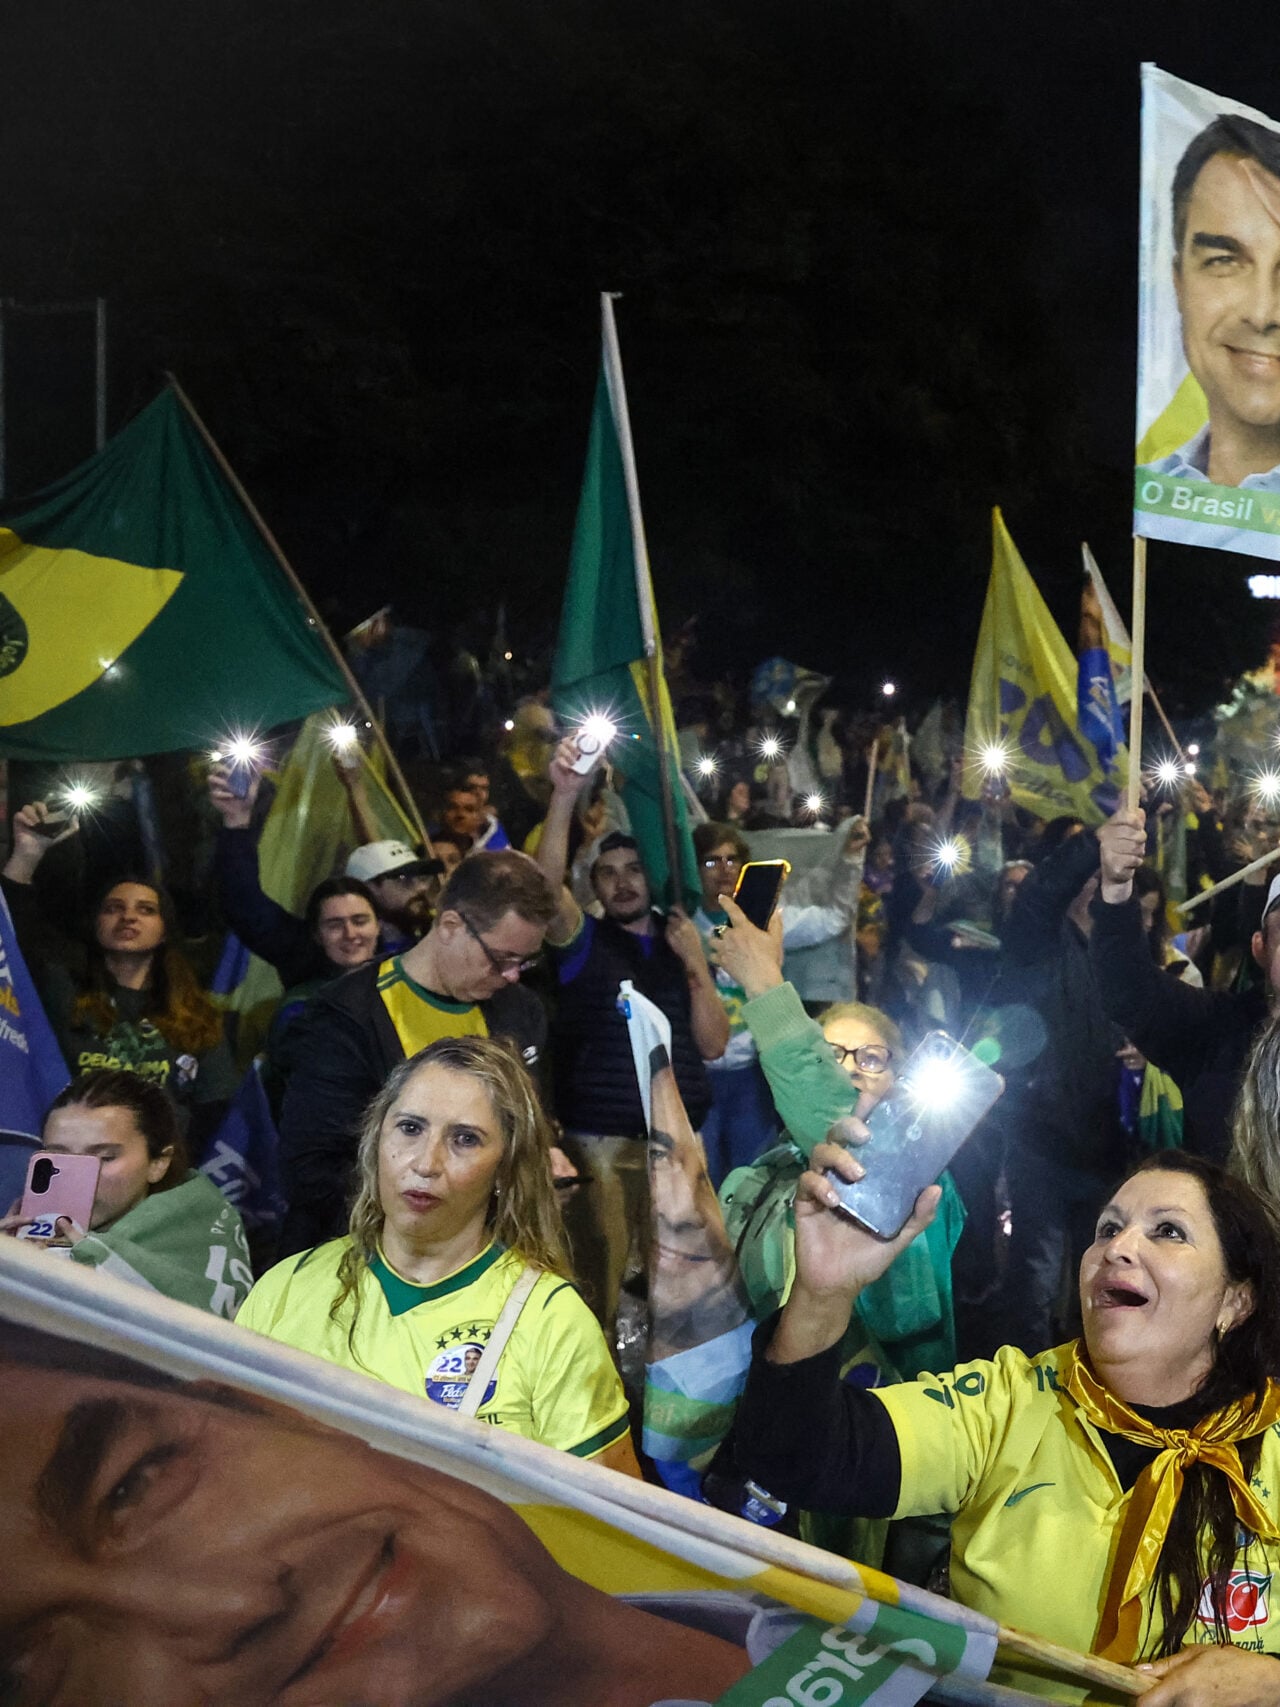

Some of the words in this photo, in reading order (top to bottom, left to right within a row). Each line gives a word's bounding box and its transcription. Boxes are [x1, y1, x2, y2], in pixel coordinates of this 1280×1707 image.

[1141, 481, 1163, 504] O
[1171, 486, 1253, 521] Brasil
[27, 1222, 53, 1237] 22
[436, 1356, 463, 1373] 22
